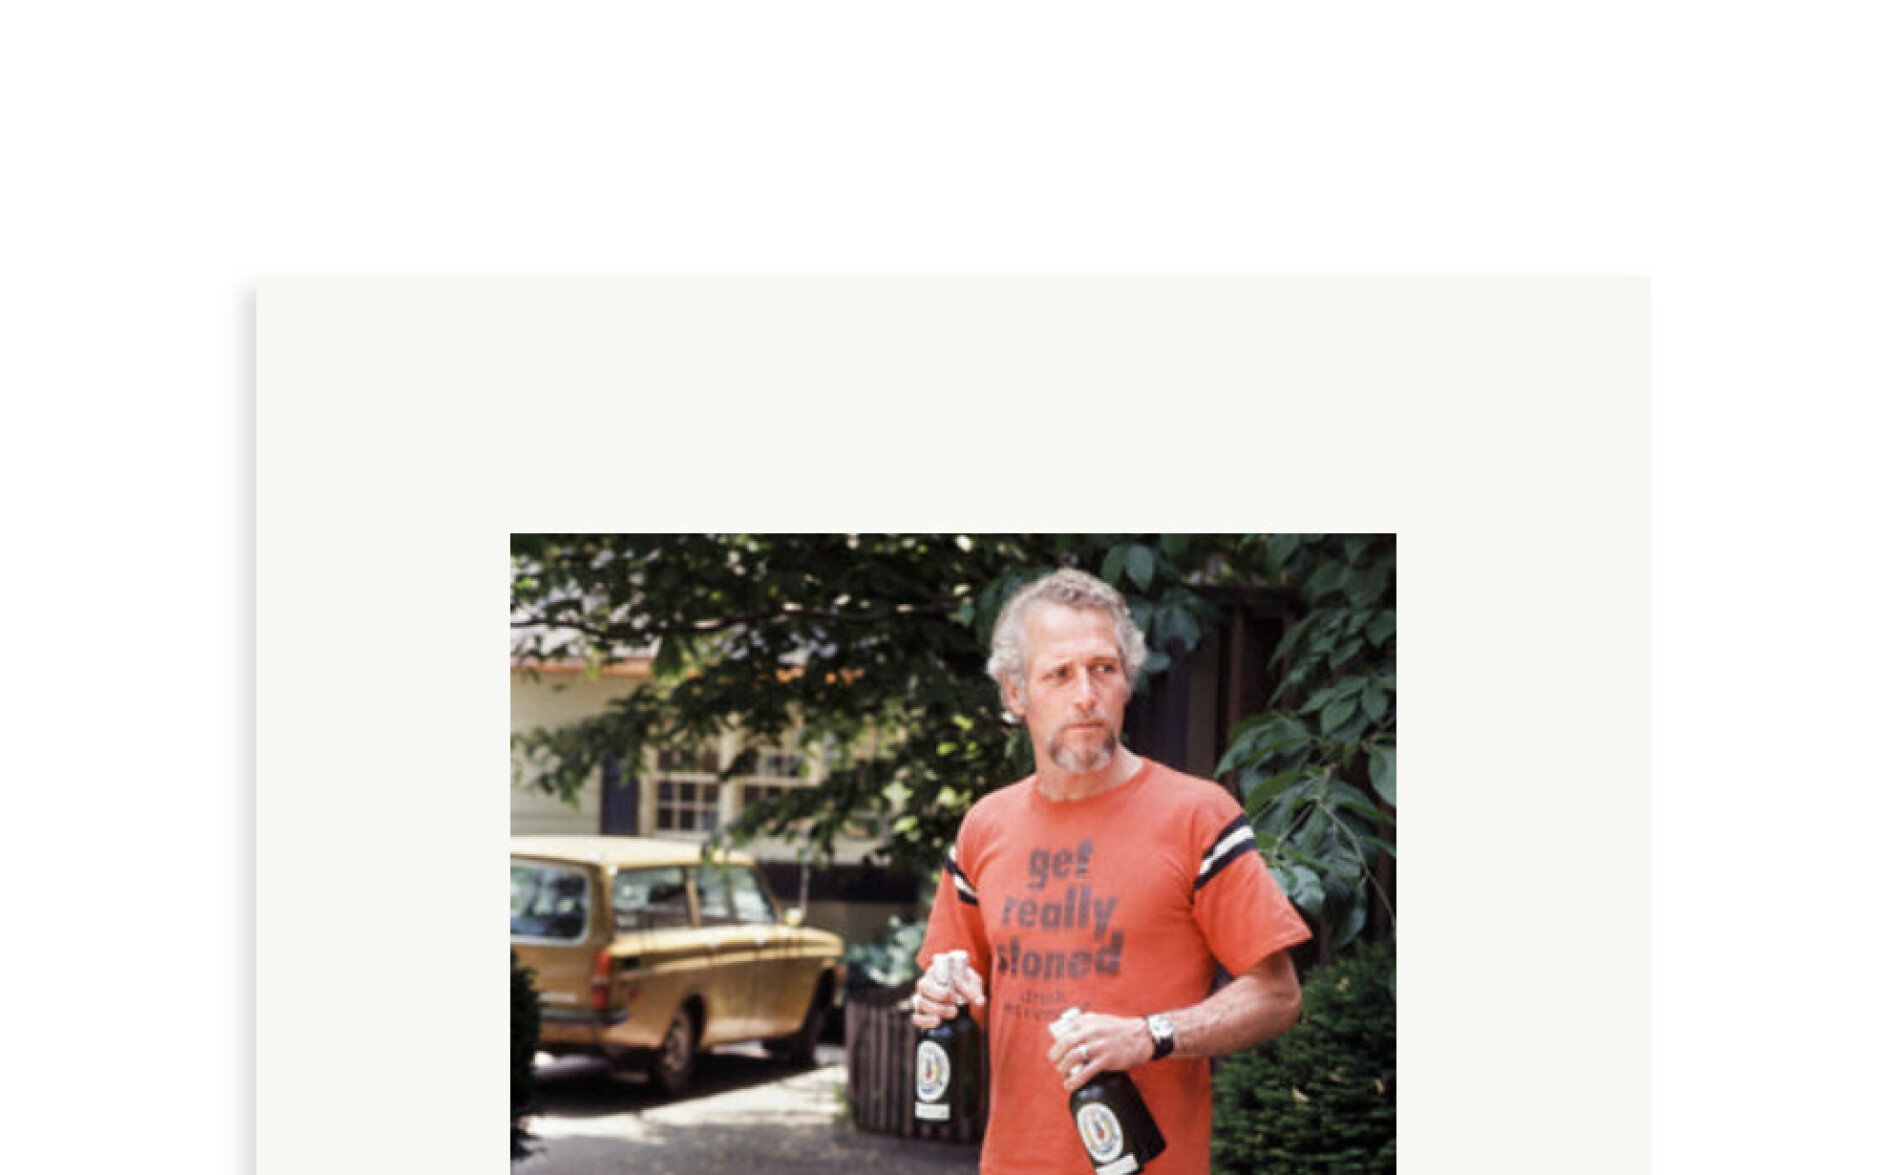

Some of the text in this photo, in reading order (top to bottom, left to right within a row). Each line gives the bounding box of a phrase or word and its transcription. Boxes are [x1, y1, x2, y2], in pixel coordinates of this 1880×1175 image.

[1027, 838, 1093, 889] get
[1002, 885, 1119, 939] really
[997, 930, 1124, 979] stoned
